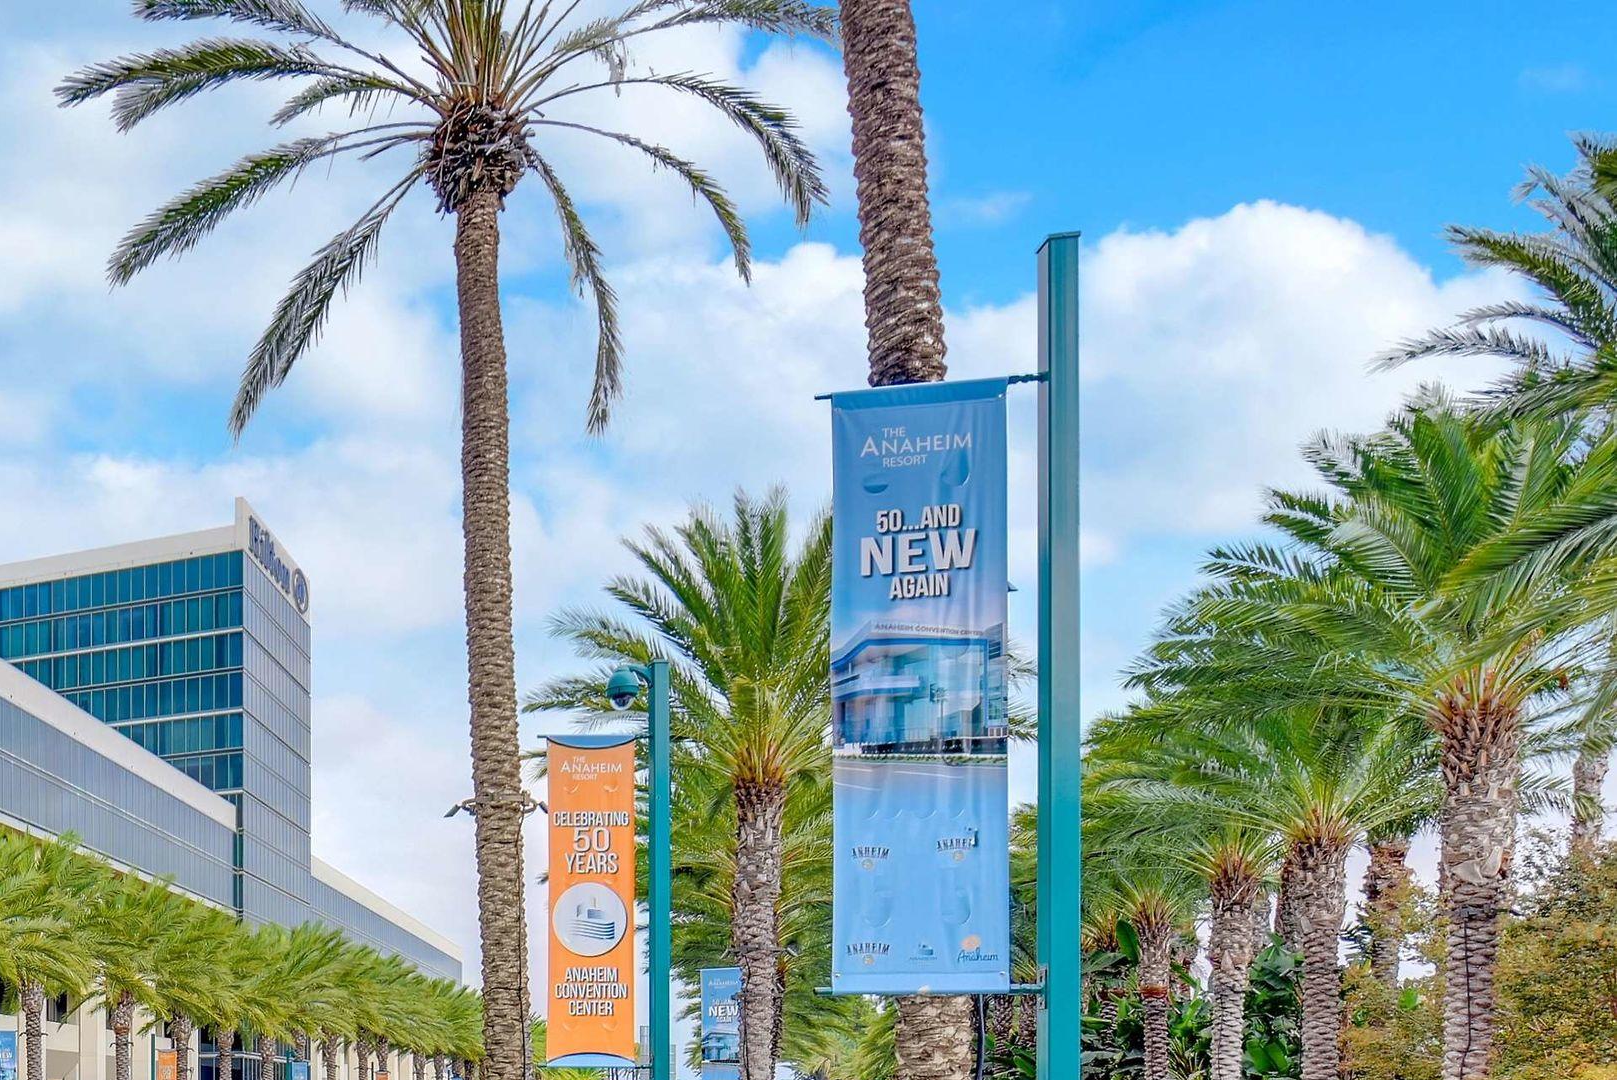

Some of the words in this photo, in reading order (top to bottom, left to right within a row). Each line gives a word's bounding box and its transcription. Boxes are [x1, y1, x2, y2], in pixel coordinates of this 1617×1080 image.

[882, 427, 906, 438] THE
[860, 432, 972, 458] ANAHEIM
[882, 454, 928, 469] RESORT
[876, 504, 962, 533] 50...AND
[248, 515, 291, 594] Hilton
[860, 528, 977, 577] NEW
[889, 572, 950, 600] AGAIN
[560, 761, 623, 774] ANAHEIM
[553, 811, 630, 827] CELEBRATING
[573, 826, 611, 853] 50
[564, 852, 619, 875] YEARS
[565, 966, 619, 983] ANAHEIM
[555, 983, 629, 999] CONVENTION
[568, 1000, 615, 1016] CENTER
[708, 1005, 739, 1017] NEW
